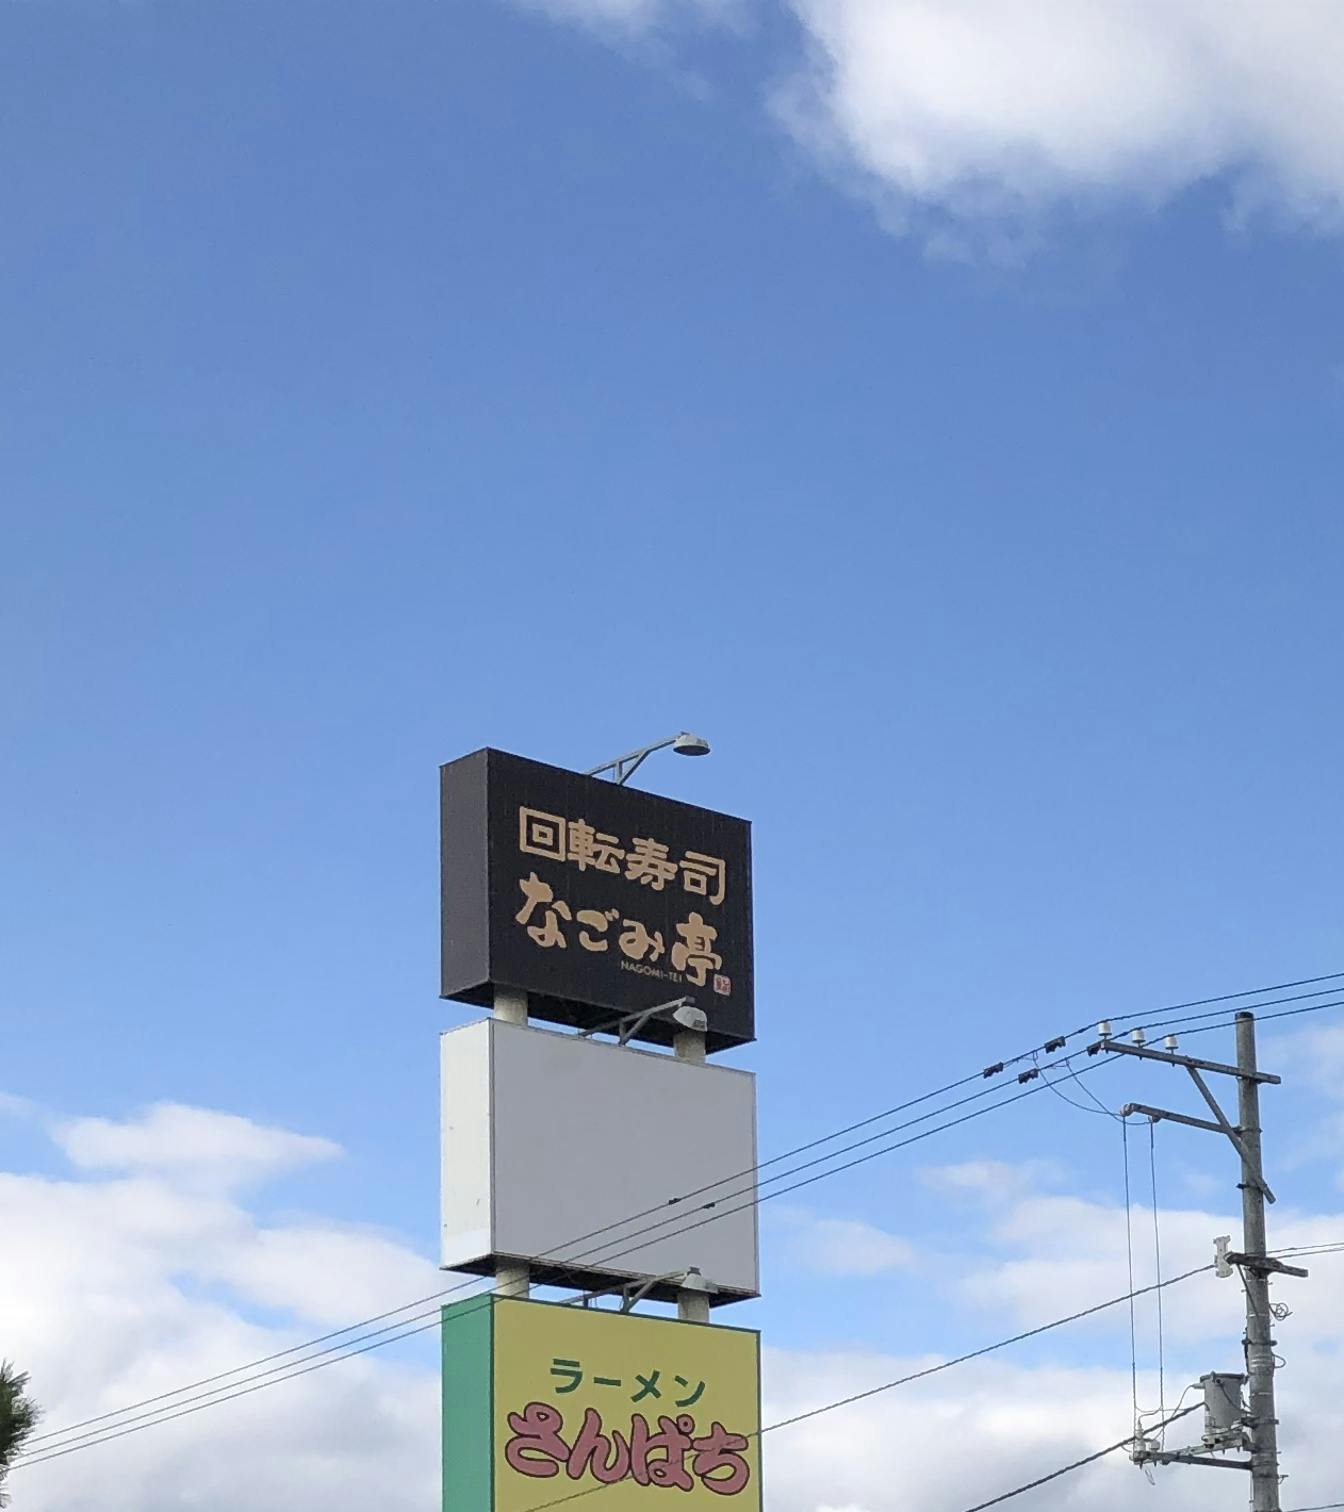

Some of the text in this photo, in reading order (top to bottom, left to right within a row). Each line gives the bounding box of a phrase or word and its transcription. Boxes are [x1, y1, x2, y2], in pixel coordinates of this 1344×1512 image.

[519, 805, 726, 905] 回転寿司
[514, 871, 722, 986] なごみ亭
[549, 1357, 706, 1407] ラーメン
[505, 1401, 751, 1496] さんぱち
